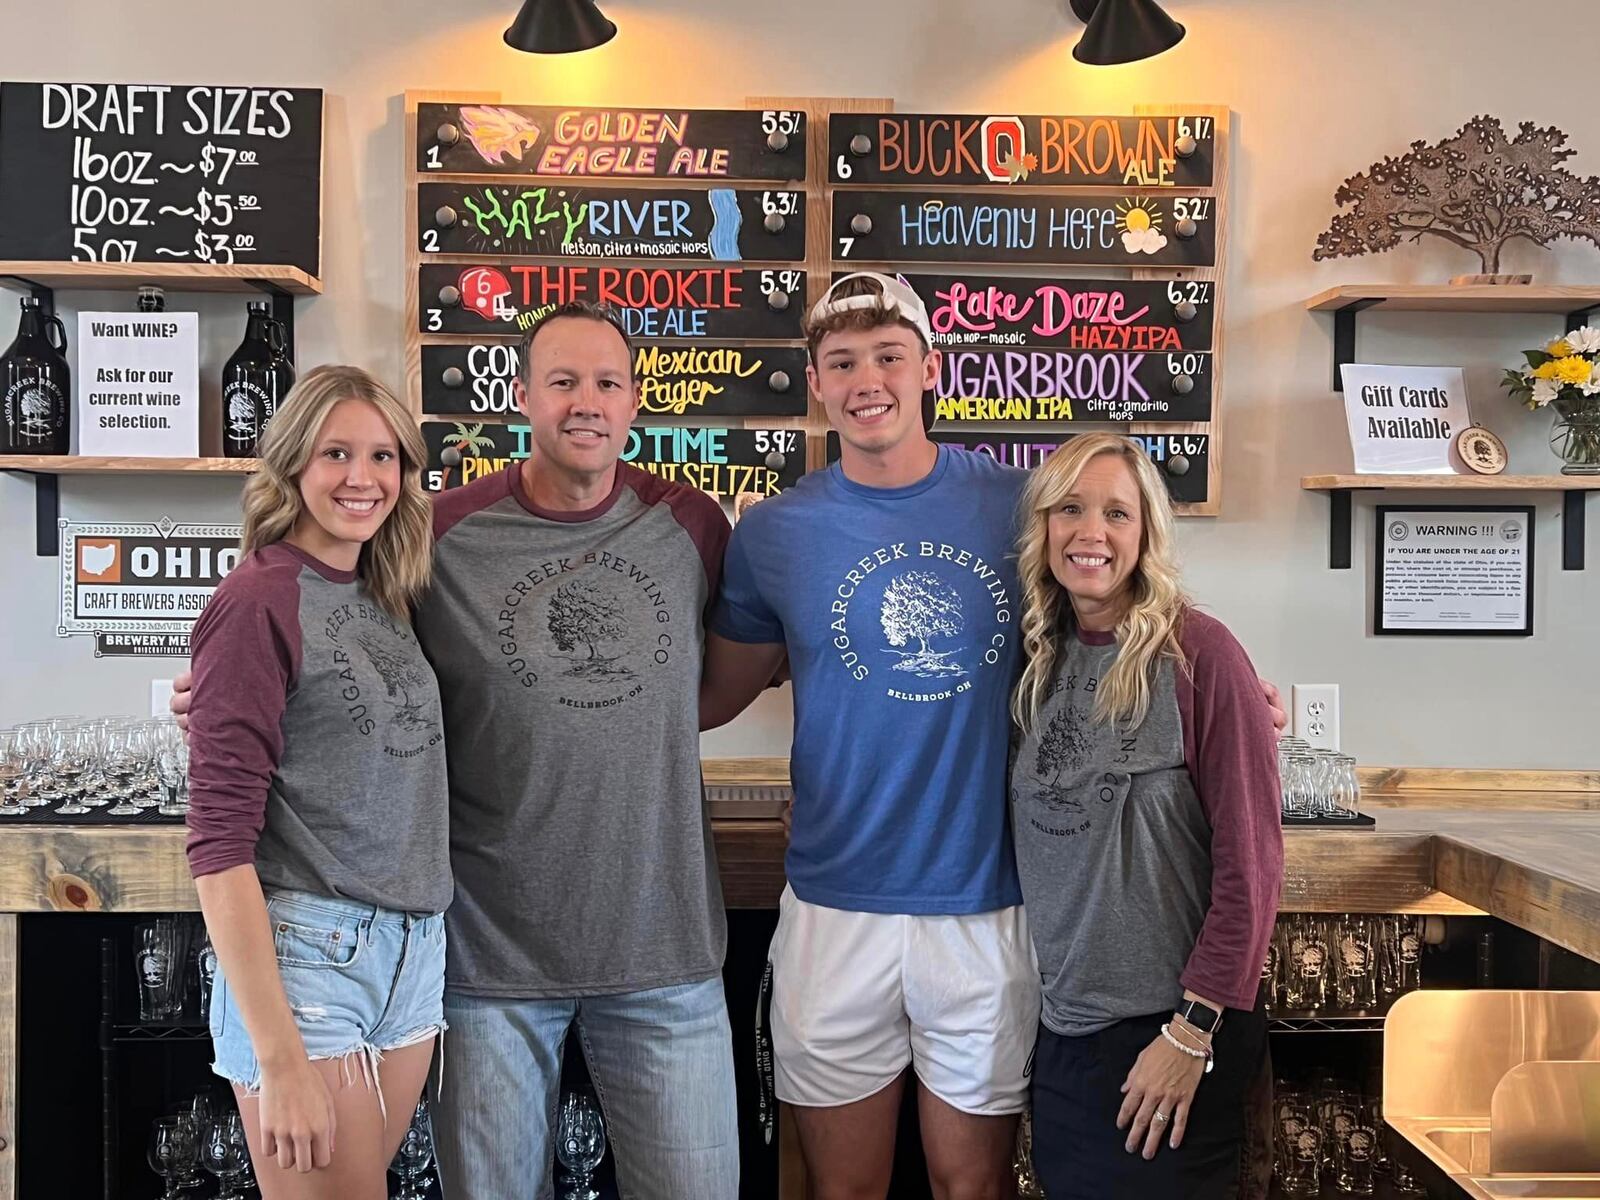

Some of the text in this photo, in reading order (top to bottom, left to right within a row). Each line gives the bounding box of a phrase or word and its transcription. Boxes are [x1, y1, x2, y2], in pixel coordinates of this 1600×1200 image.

[43, 84, 293, 138] DRAFT SIZES
[554, 111, 689, 146] GOLDEN
[426, 145, 443, 168] 1
[1040, 117, 1175, 175] BROWN
[536, 145, 730, 175] EAGLE ALE
[837, 155, 852, 178] 6
[1123, 158, 1176, 186] ALE
[463, 188, 693, 247] HAZY RIVER
[422, 229, 441, 252] 2
[838, 238, 855, 257] 7
[510, 266, 743, 309] THE ROOKIE
[1167, 281, 1209, 304] 6.2%
[427, 309, 442, 331] 3
[931, 282, 1149, 337] Lake Daze
[92, 322, 178, 338] Want WINE?
[662, 308, 708, 336] ALE
[635, 346, 763, 377] Mexican
[96, 368, 173, 383] Ask for our
[89, 390, 181, 406] current wine
[1361, 385, 1448, 408] Gift Cards
[935, 397, 1073, 420] AMERICAN IPA
[1109, 411, 1134, 421] HOPS
[99, 414, 171, 430] selection.
[1368, 416, 1451, 440] Available
[645, 427, 729, 464] TIME
[1168, 436, 1206, 456] 6.6%
[682, 462, 782, 496] SELTZER
[1416, 525, 1478, 537] WARNING
[84, 592, 117, 609] CRAFT
[121, 593, 174, 610] BREWERS
[830, 543, 908, 681] SUGARCREEK
[919, 541, 1011, 624] BREWING
[498, 558, 575, 688] SUGARCREEK
[584, 551, 670, 624] BREWING
[106, 635, 165, 646] BREWERY
[325, 604, 376, 736] SUGARREEK
[629, 684, 643, 697] OH
[956, 681, 972, 693] OH
